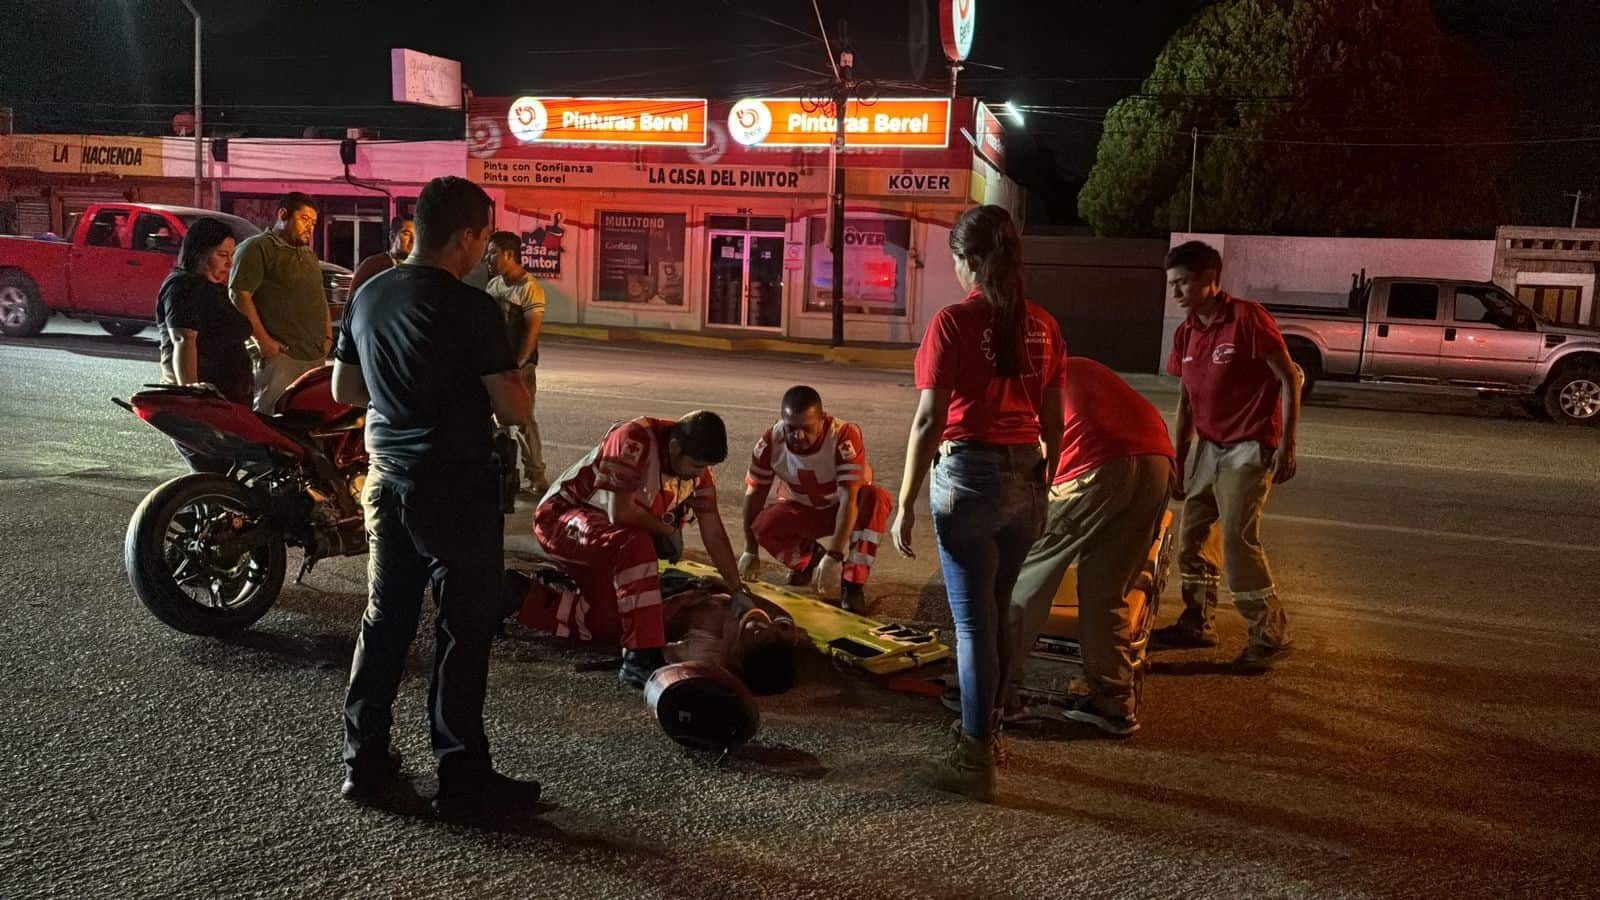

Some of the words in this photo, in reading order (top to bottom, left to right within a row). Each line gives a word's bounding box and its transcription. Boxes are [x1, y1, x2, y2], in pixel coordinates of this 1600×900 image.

[562, 111, 636, 131] Pinturas
[640, 112, 689, 132] Berel
[787, 113, 870, 132] Pintuas
[874, 113, 929, 133] Berel
[53, 143, 69, 164] LA
[82, 145, 142, 166] HACIENDA
[483, 160, 509, 171] Pinta
[512, 163, 531, 171] con
[535, 162, 593, 174] Confianza
[483, 171, 509, 182] Pinta
[512, 173, 530, 182] con
[535, 173, 567, 184] Berel
[649, 167, 666, 184] LA
[669, 168, 706, 185] CASA
[710, 169, 737, 186] DEL
[740, 170, 799, 188] PINTOR
[521, 255, 558, 269] Pintor
